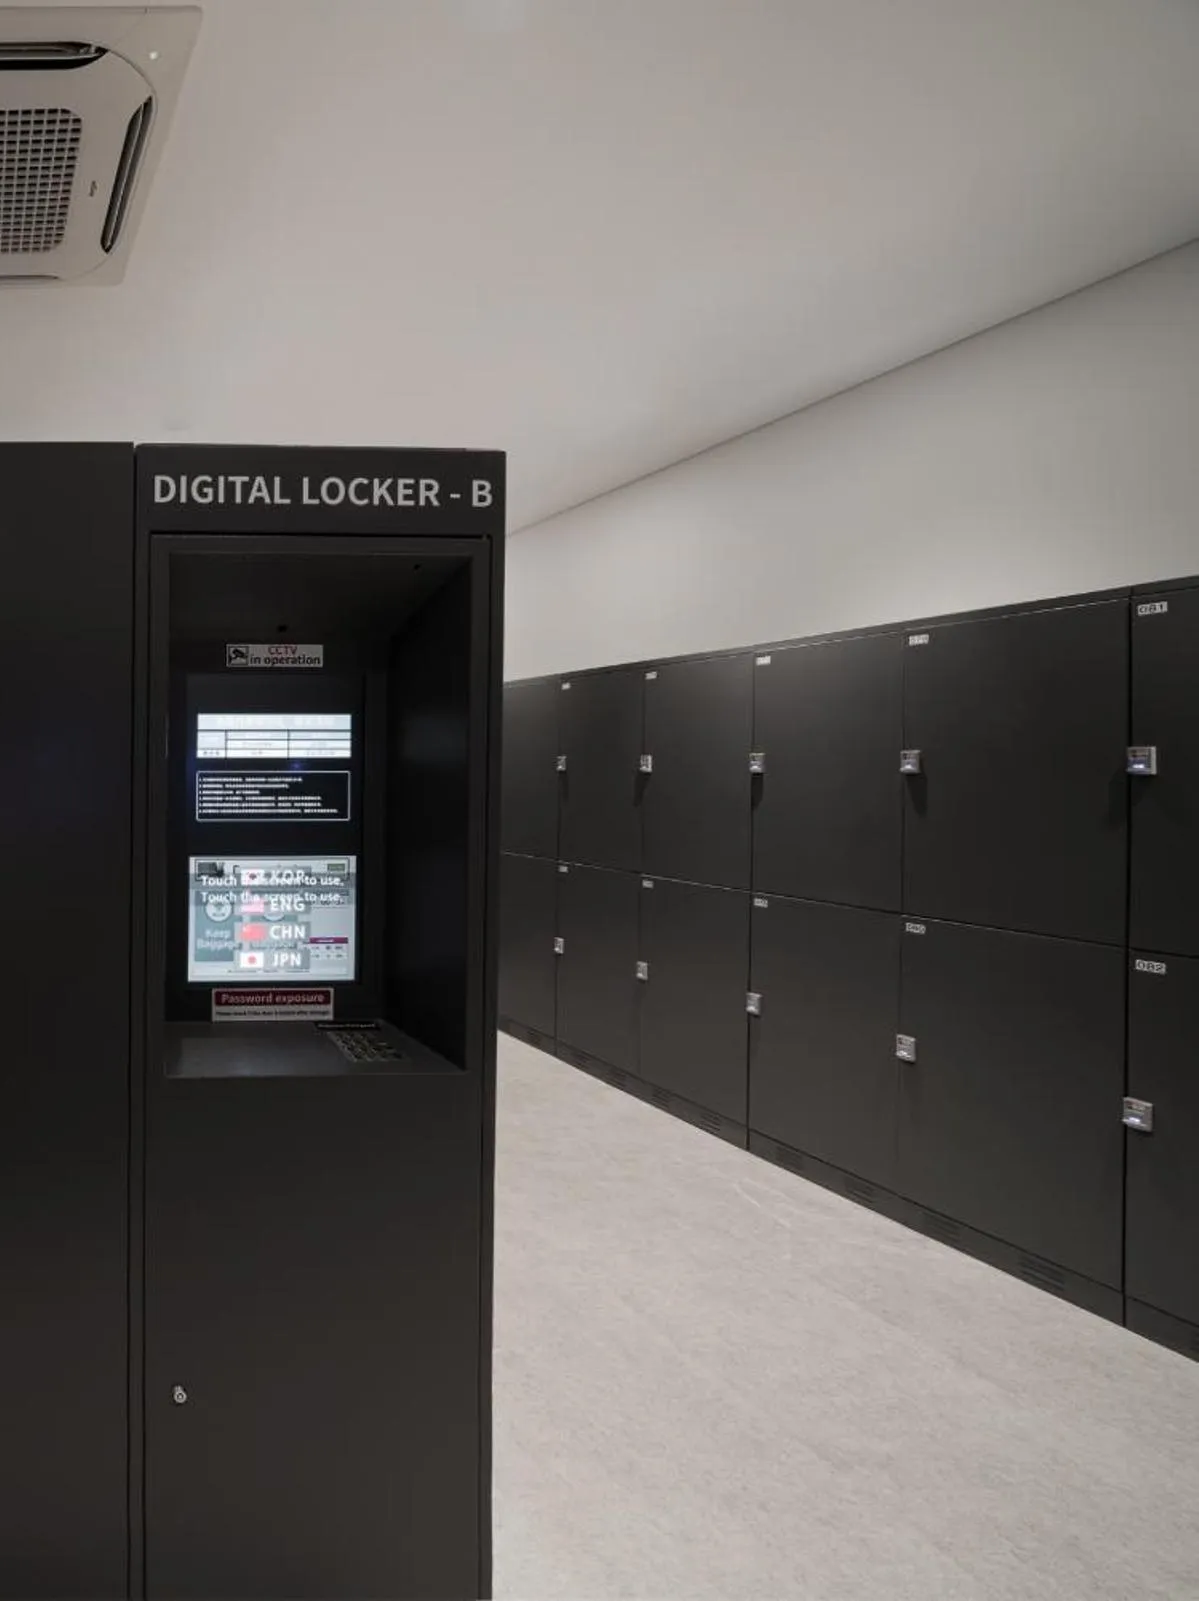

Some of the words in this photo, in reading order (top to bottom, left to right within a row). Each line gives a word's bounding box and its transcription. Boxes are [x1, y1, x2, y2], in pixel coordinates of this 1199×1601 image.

[154, 475, 291, 504] DIGITAL
[302, 477, 440, 506] LOCKER
[471, 480, 493, 507] B
[267, 645, 298, 655] CCTV
[250, 655, 261, 665] in
[263, 655, 321, 667] operation
[201, 875, 237, 886] Touch
[304, 876, 317, 886] to
[201, 891, 237, 903] Touch
[304, 891, 317, 902] to
[270, 898, 306, 912] ENG
[269, 925, 306, 939] CHN
[272, 952, 302, 967] JPN
[221, 993, 273, 1003] Password
[275, 993, 325, 1005] exposure
